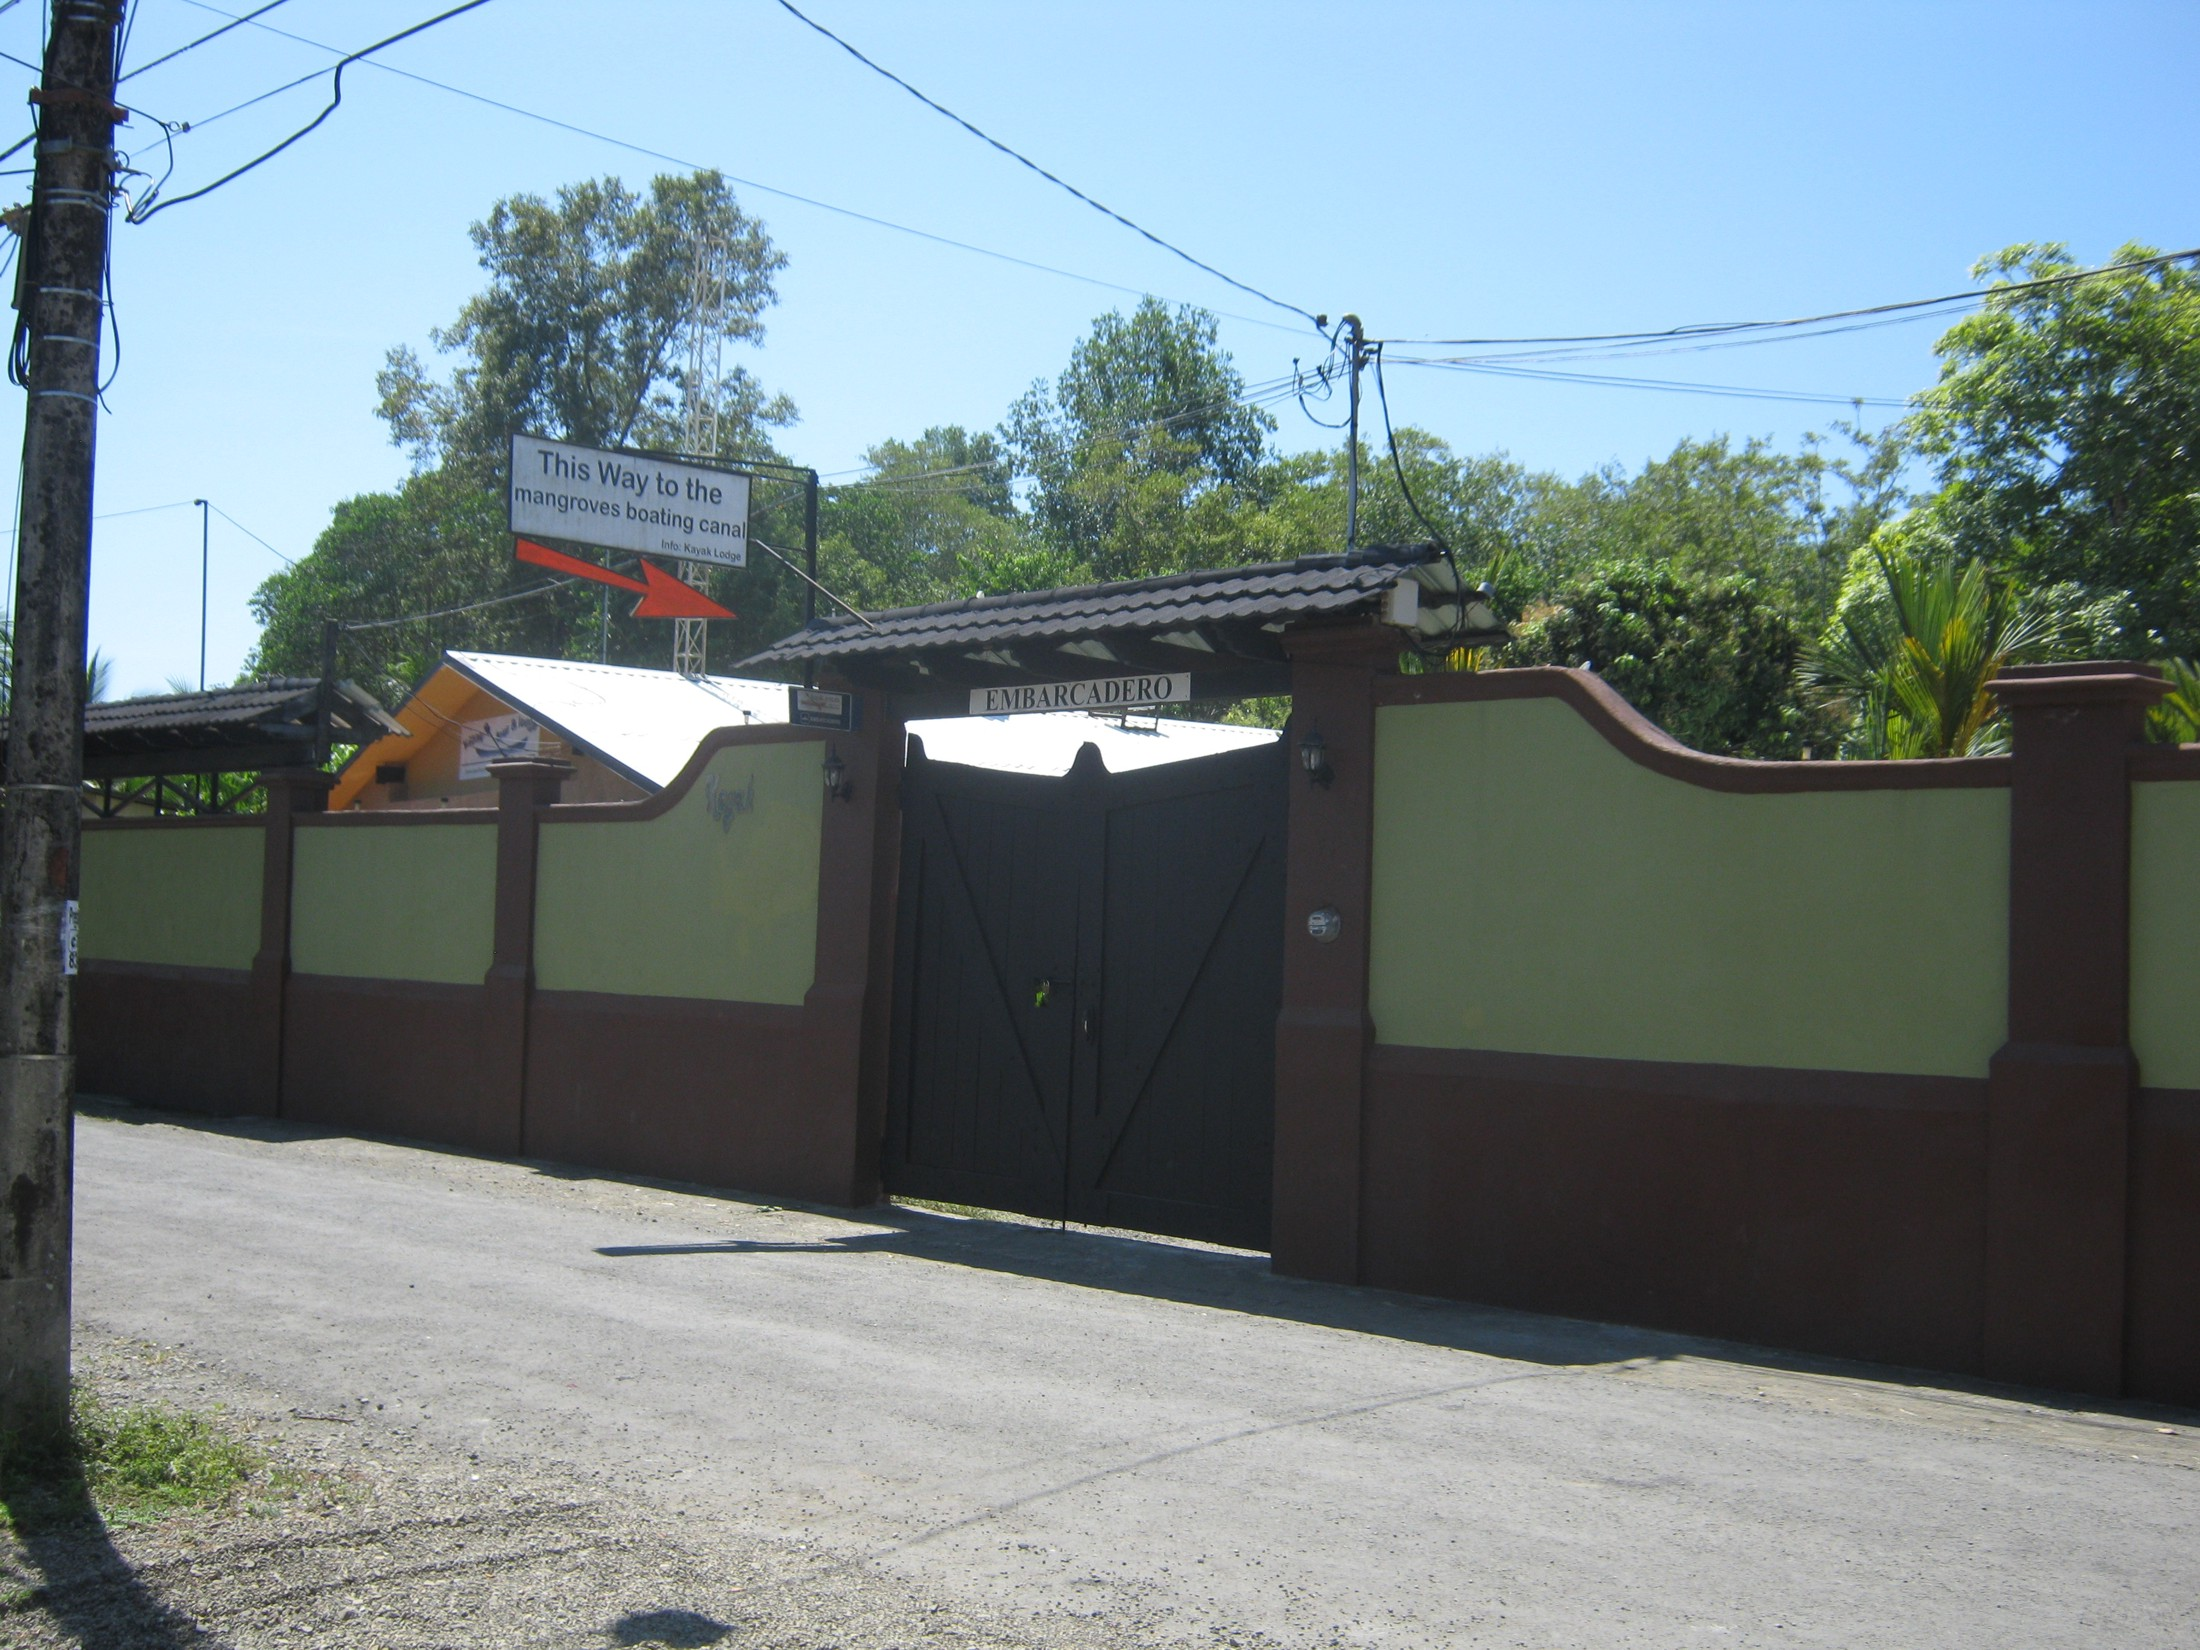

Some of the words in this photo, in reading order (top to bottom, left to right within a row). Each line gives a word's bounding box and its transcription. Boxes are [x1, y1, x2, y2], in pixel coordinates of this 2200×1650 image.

[538, 450, 591, 481] This
[598, 460, 648, 497] Way
[656, 472, 678, 497] to
[686, 478, 722, 505] the
[514, 486, 621, 518] mangroves
[626, 501, 694, 534] boating
[699, 519, 747, 540] canal
[661, 539, 682, 552] Info:
[683, 542, 712, 557] Kayak
[714, 548, 742, 562] Lodge
[985, 676, 1173, 712] EMBARCADERO
